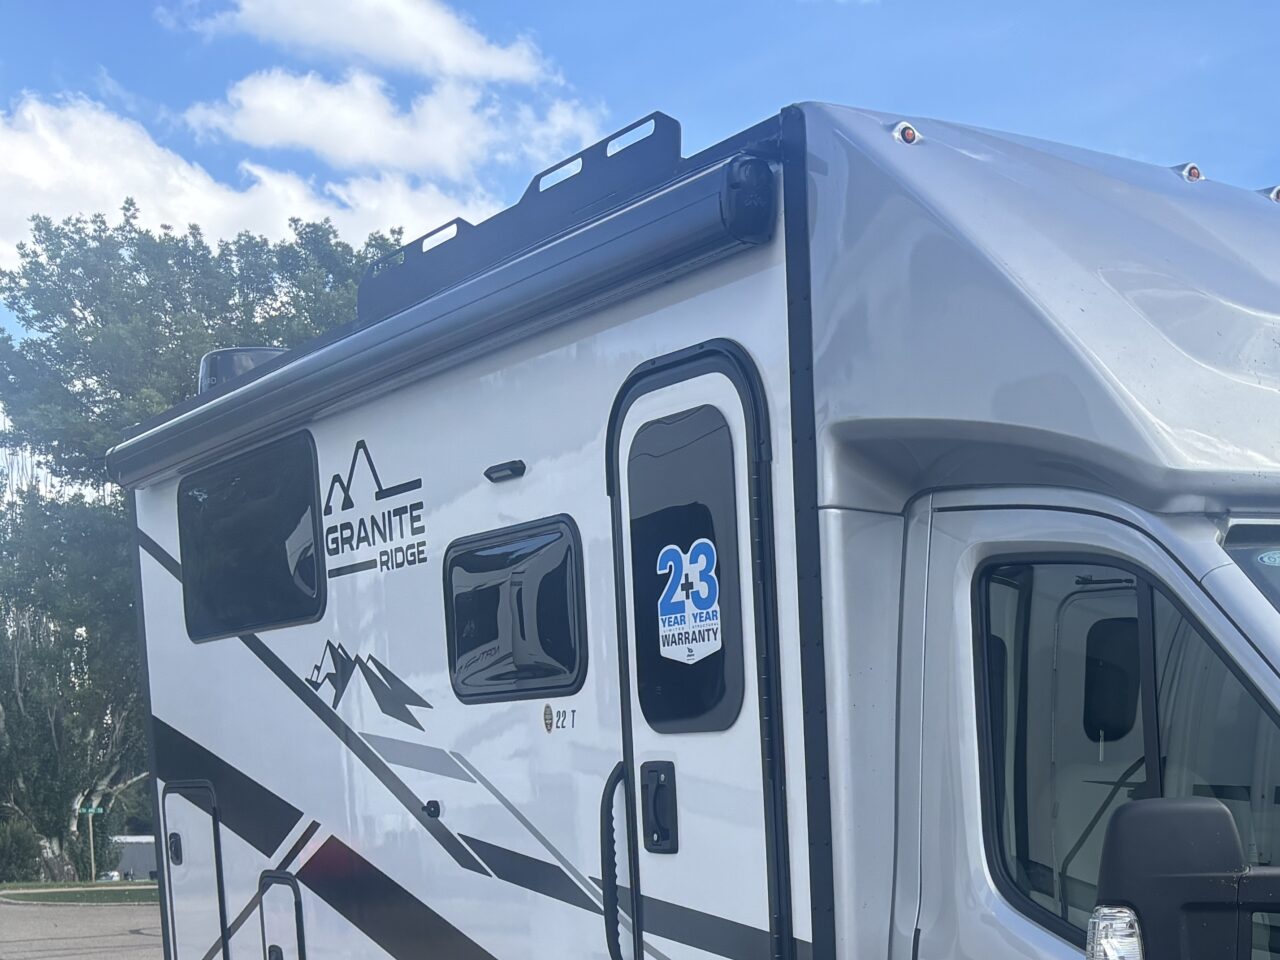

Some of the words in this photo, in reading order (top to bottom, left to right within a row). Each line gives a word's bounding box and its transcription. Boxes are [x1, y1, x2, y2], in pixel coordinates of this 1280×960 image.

[325, 501, 426, 557] GRANITE
[379, 540, 428, 573] RIDGE
[661, 614, 686, 628] YEAR
[692, 609, 718, 623] YEAR
[661, 627, 719, 647] WARRANTY
[555, 710, 567, 729] 22
[571, 709, 577, 729] T
